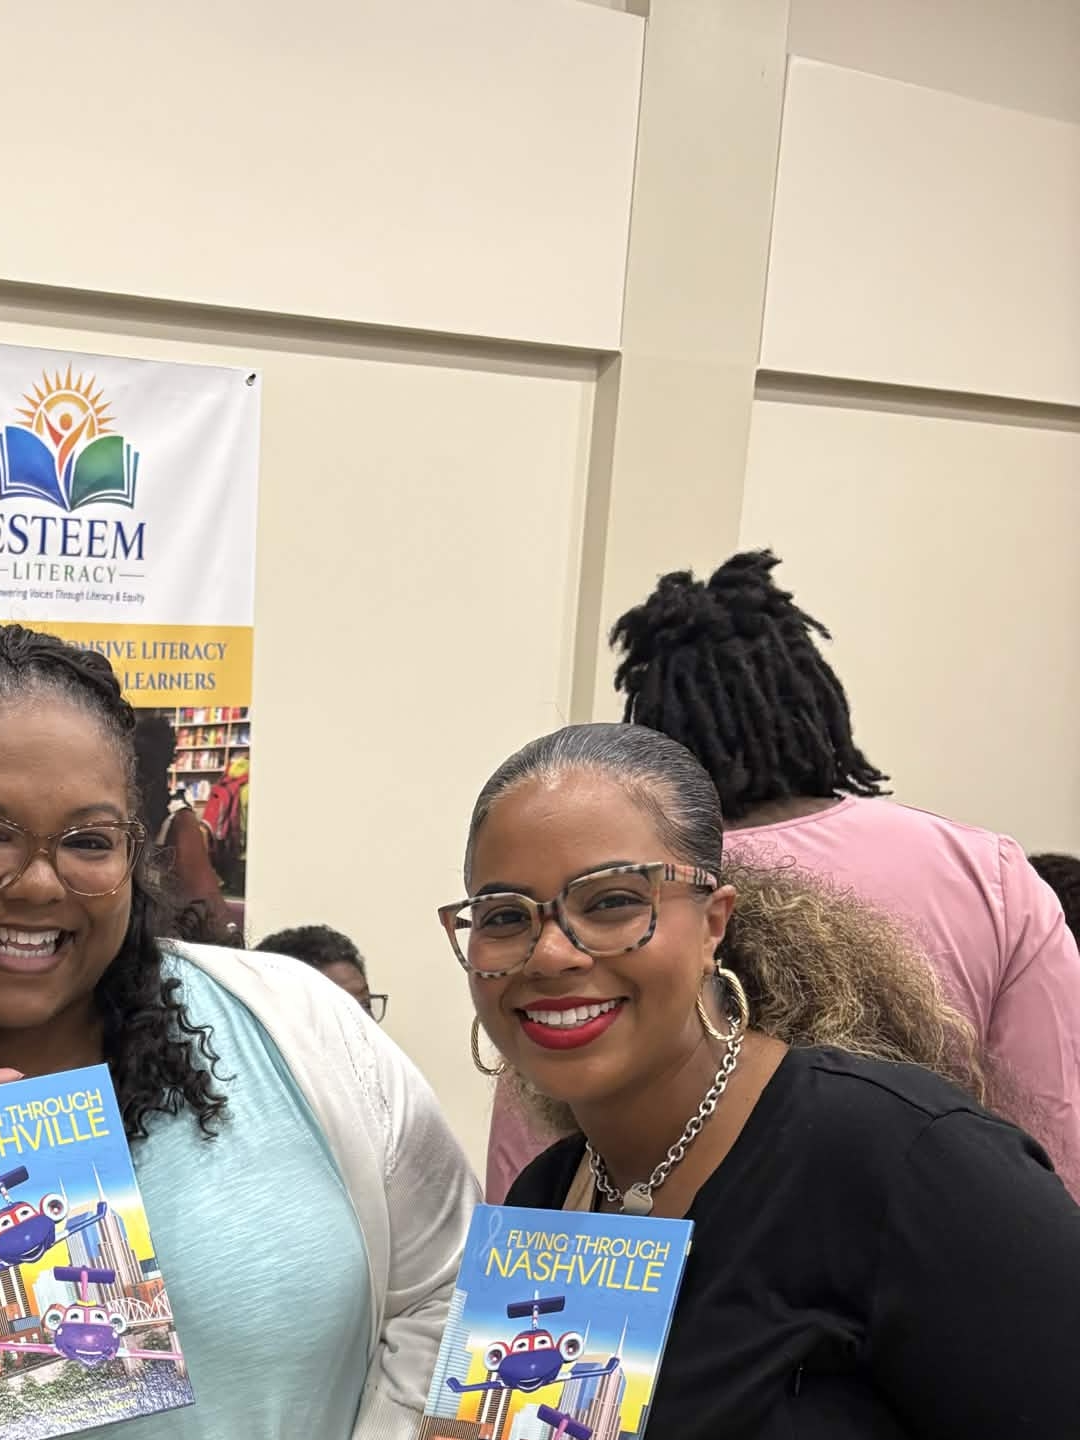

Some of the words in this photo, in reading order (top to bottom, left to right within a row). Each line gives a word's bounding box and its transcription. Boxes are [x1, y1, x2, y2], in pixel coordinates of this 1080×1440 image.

[12, 561, 118, 584] LITERACY
[30, 588, 53, 600] Voices
[55, 589, 85, 602] Through
[86, 590, 114, 604] Literacy
[122, 591, 145, 605] Equity
[142, 640, 227, 661] LITERACY
[124, 671, 217, 690] LEARNERS
[5, 1087, 103, 1124] THROUGH
[506, 1229, 569, 1252] FLYING
[575, 1234, 671, 1261] THROUGH
[484, 1247, 666, 1293] NASHVILLE
